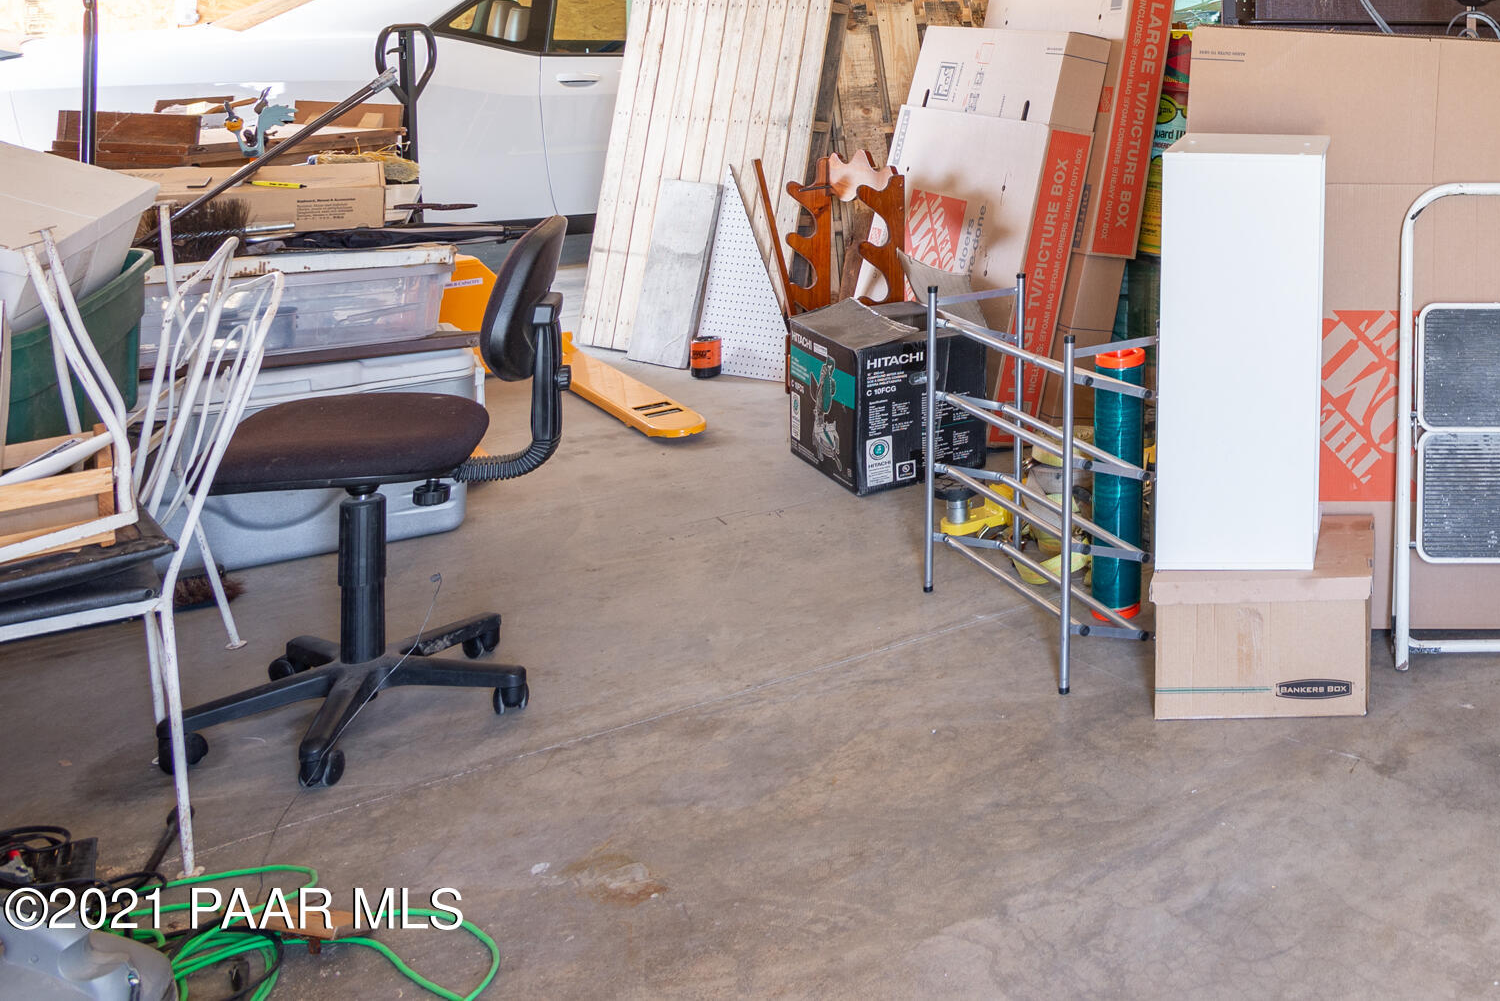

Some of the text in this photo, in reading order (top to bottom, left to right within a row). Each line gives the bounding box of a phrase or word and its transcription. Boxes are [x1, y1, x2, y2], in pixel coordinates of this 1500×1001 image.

[1114, 2, 1165, 228] LARGE TV/PICTURE BOX
[959, 219, 974, 270] doers
[1028, 202, 1060, 310] TV/PICTURE
[1051, 158, 1069, 196] BOX
[791, 330, 813, 351] HITACHI
[866, 351, 924, 370] HITACHI
[866, 386, 897, 397] C 10FCG
[1281, 685, 1347, 694] BANKERS BOX
